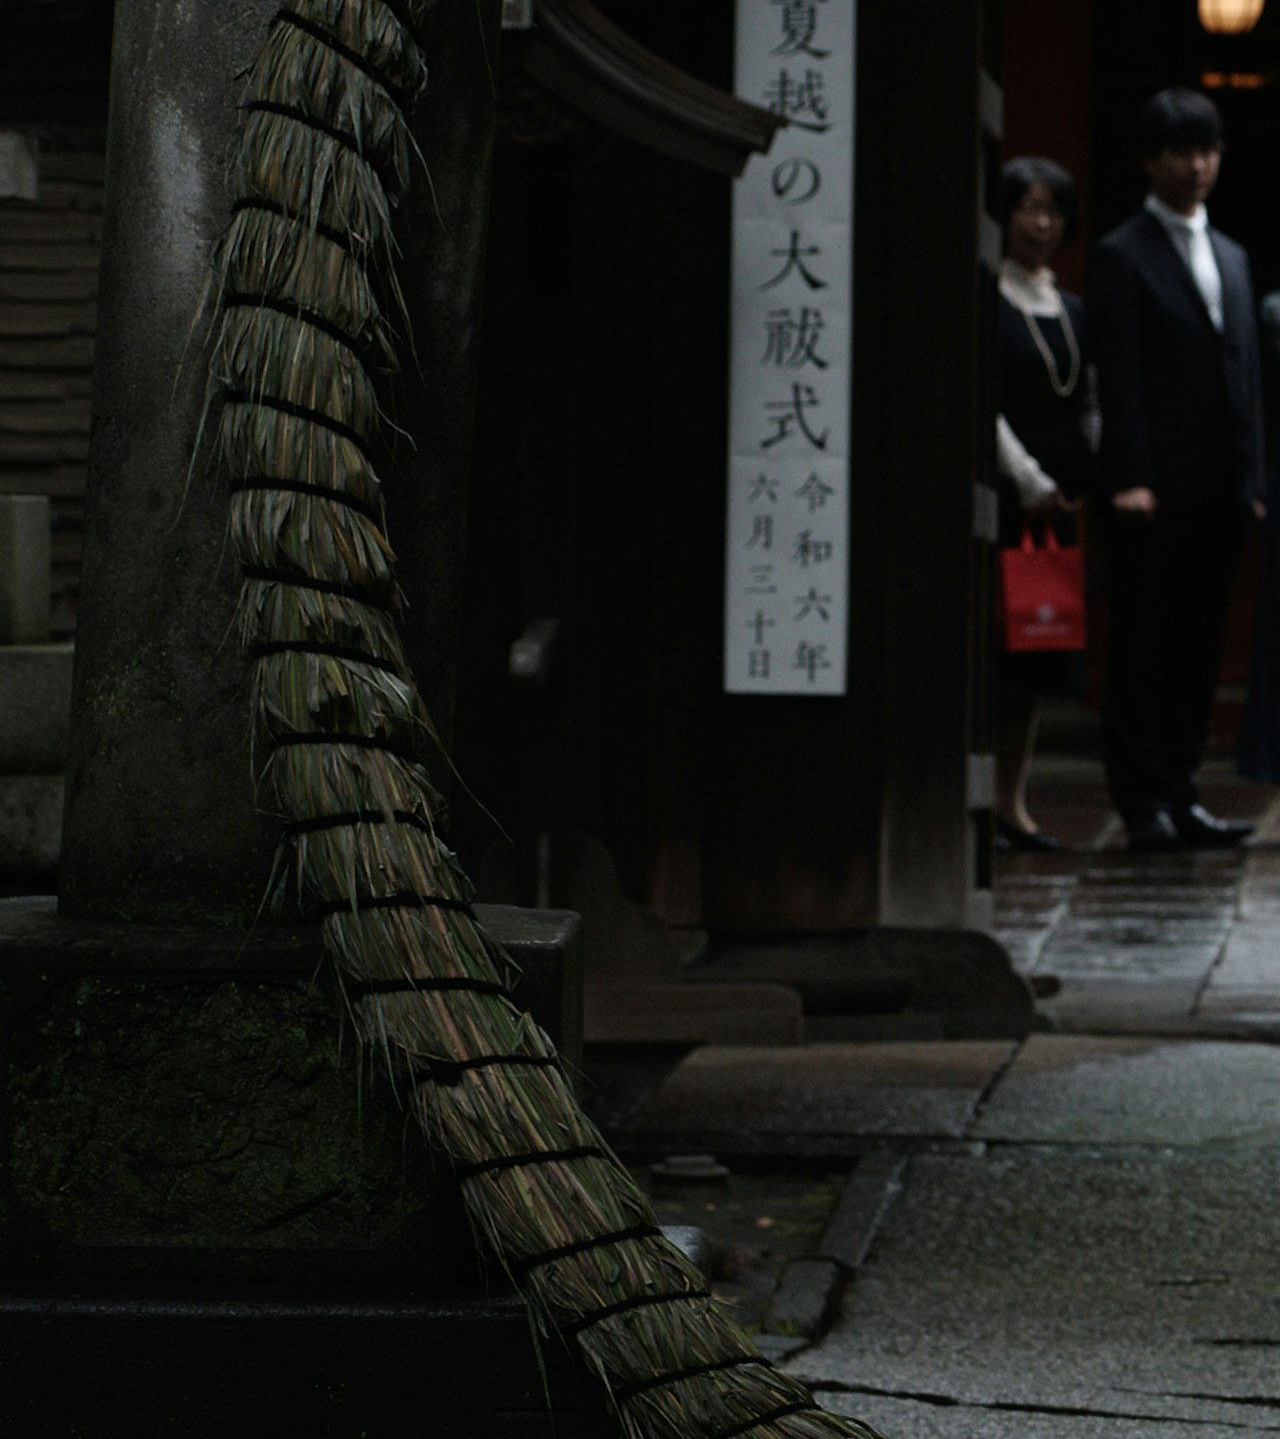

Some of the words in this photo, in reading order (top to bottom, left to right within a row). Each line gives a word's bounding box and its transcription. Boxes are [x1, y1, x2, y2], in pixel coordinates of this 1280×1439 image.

[745, 473, 779, 679] 六月三十日
[793, 473, 834, 683] 令和六年
